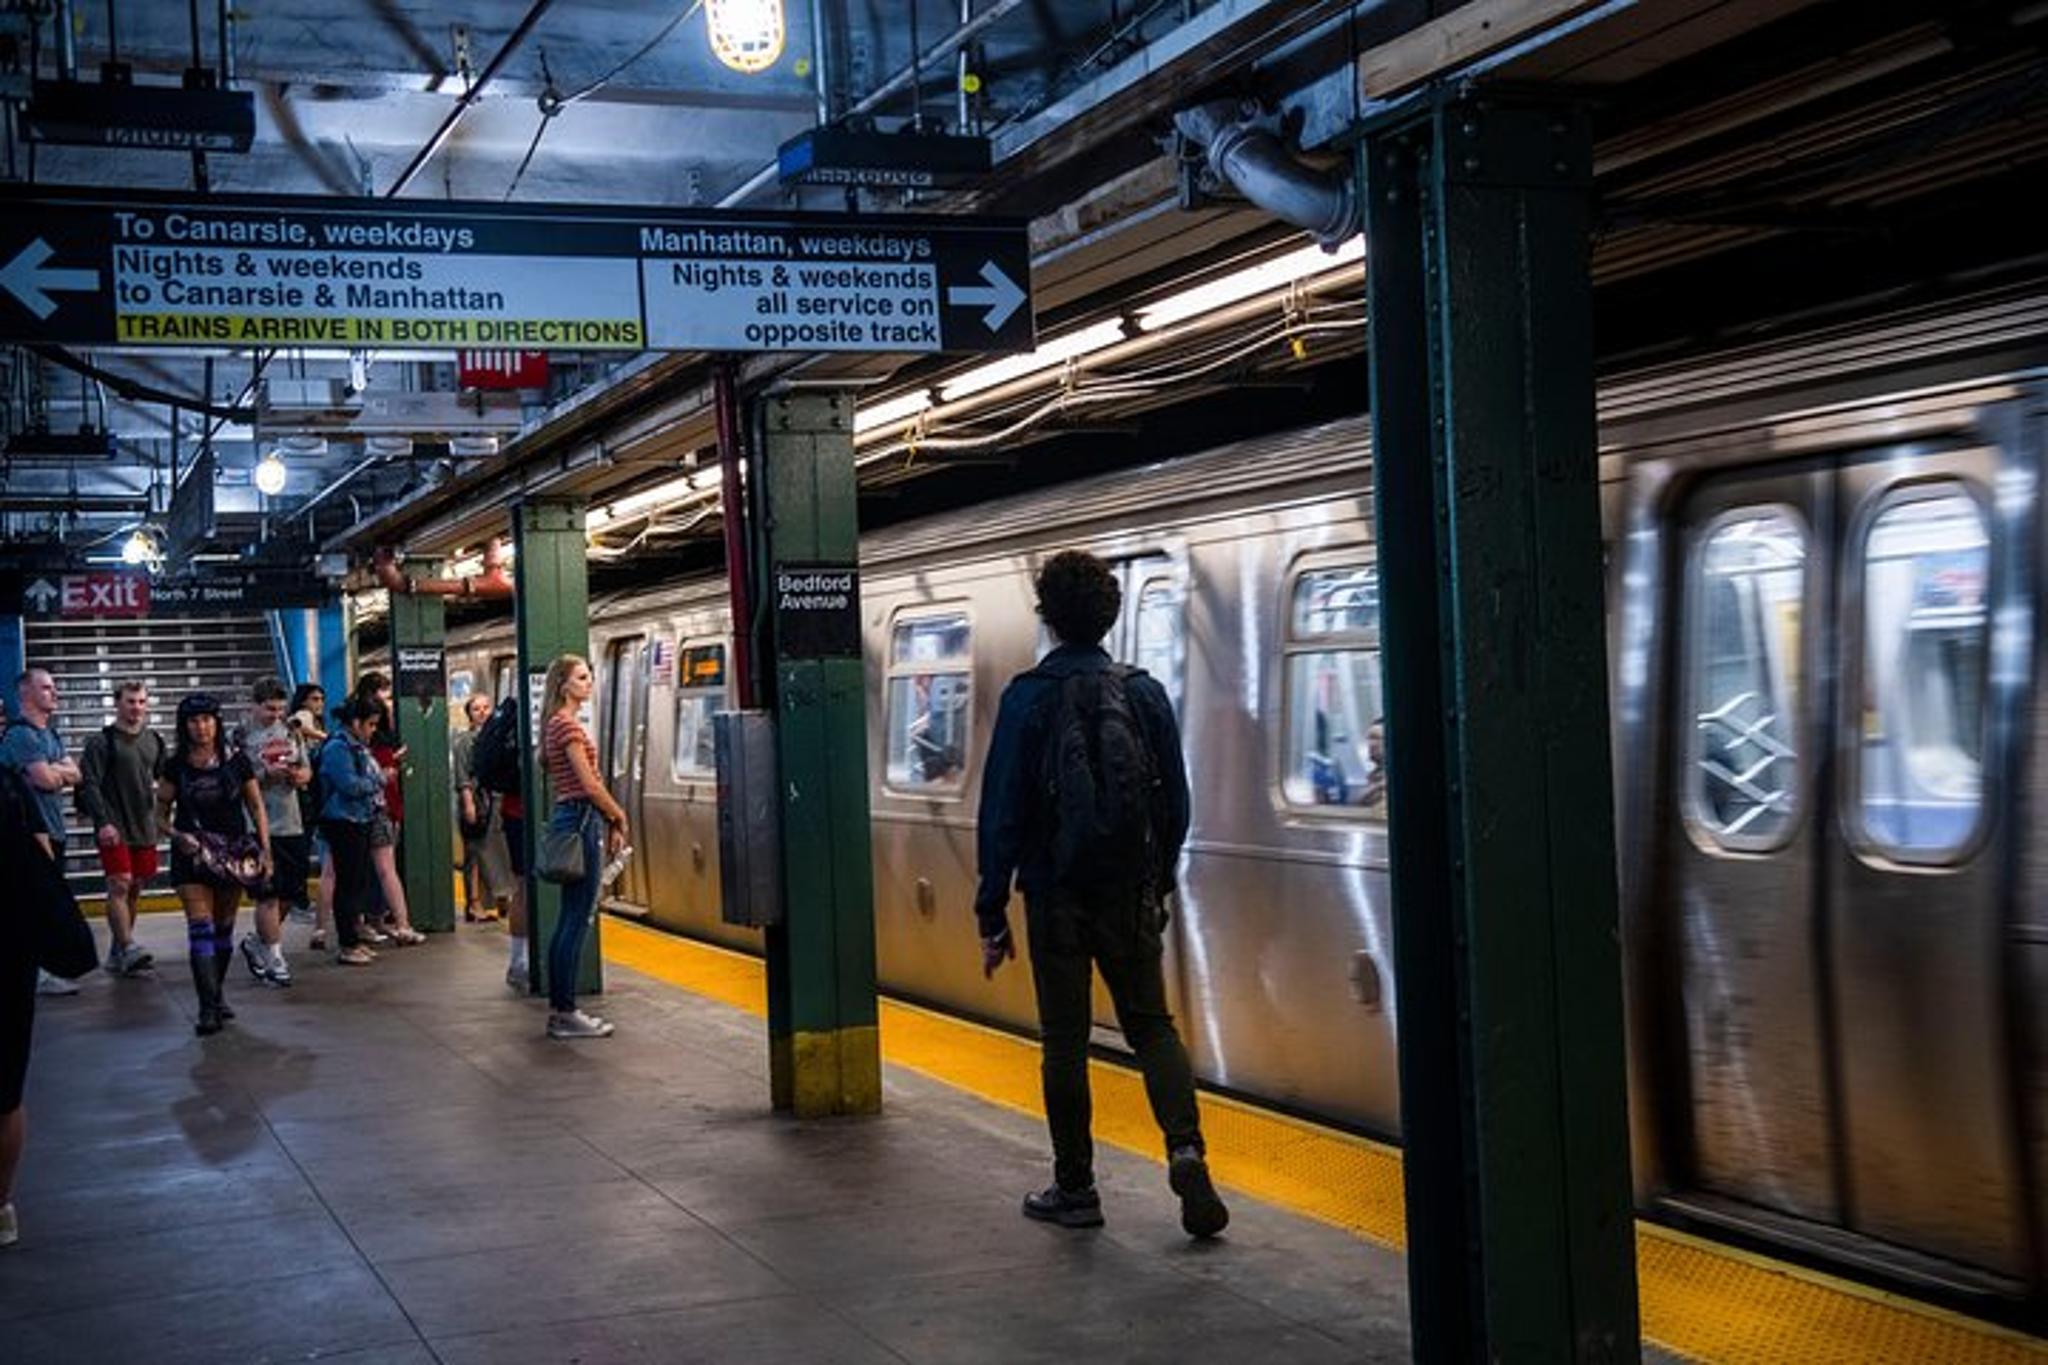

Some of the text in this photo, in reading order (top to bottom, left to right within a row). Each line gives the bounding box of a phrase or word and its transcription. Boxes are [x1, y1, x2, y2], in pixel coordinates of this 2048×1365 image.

[114, 212, 475, 253] To Canarsie, weekdays
[639, 226, 932, 262] Manhattan, weekdays
[118, 249, 422, 280] Nights & weekends
[673, 262, 932, 292] Nights & weekends
[118, 279, 505, 311] to Canarsie & Manhattan
[756, 292, 934, 316] all service on
[120, 315, 639, 343] TRAINS ARRIVE IN BOTH DIRECTIONS
[745, 319, 937, 347] opposite track
[61, 575, 140, 609] Exit
[150, 587, 243, 602] North 7 Street
[778, 573, 852, 592] Bedford
[779, 593, 849, 610] Avenue
